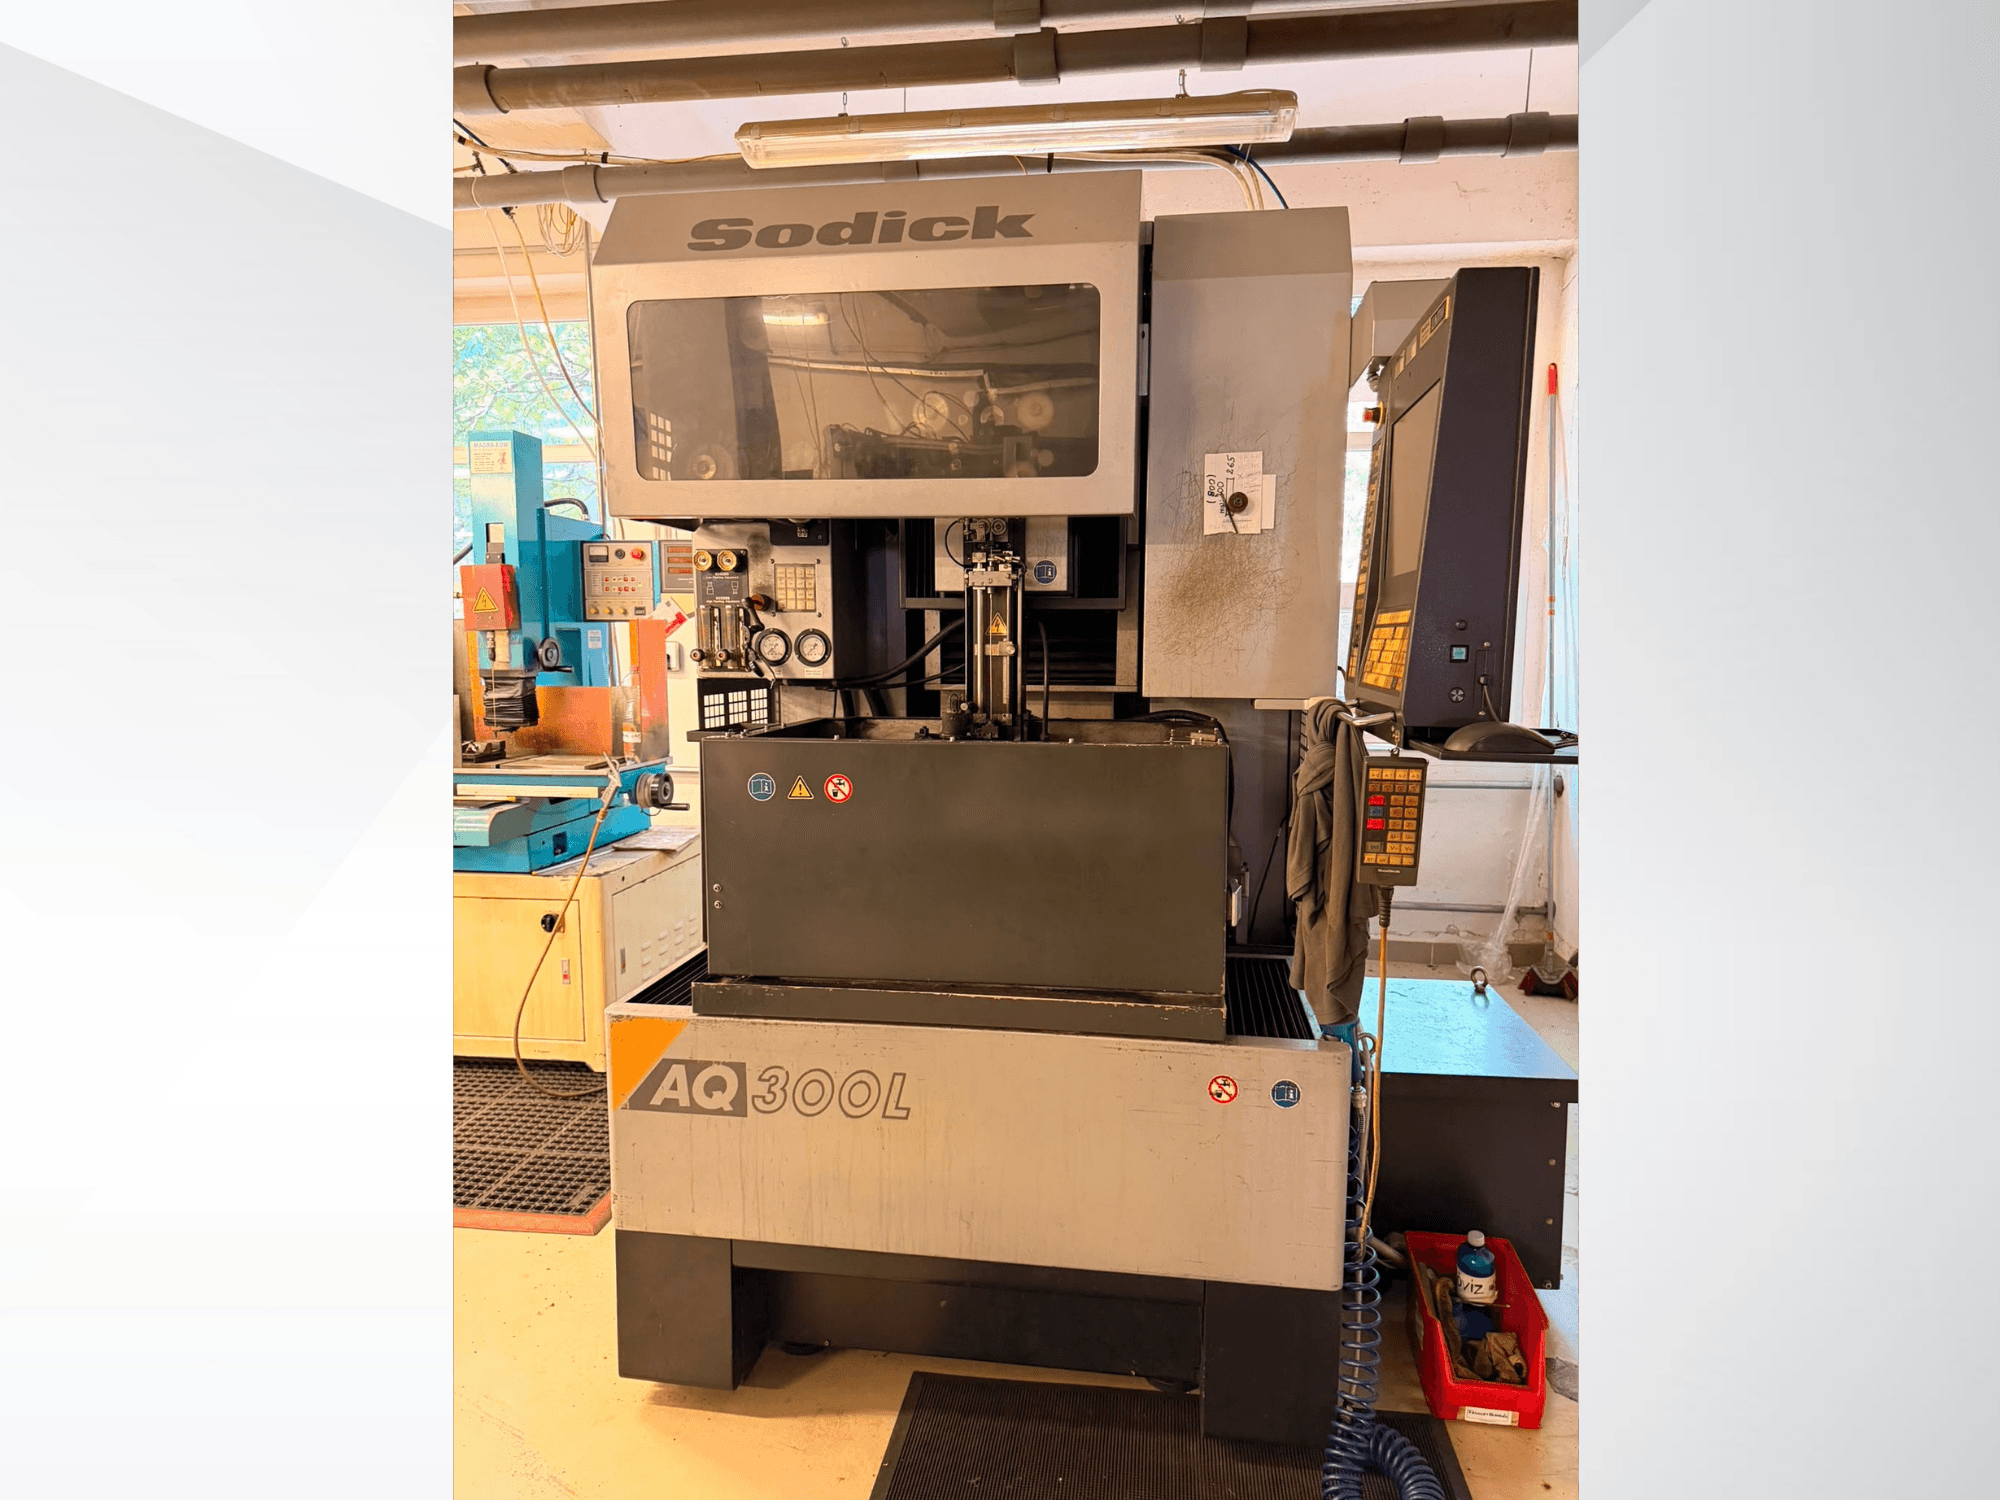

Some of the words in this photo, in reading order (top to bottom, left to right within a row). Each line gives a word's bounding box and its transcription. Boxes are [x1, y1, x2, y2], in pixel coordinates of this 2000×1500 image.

[687, 205, 1037, 252] Sodick
[1225, 454, 1236, 475] 265
[649, 1063, 739, 1112] AQ
[752, 1065, 911, 1120] 300L
